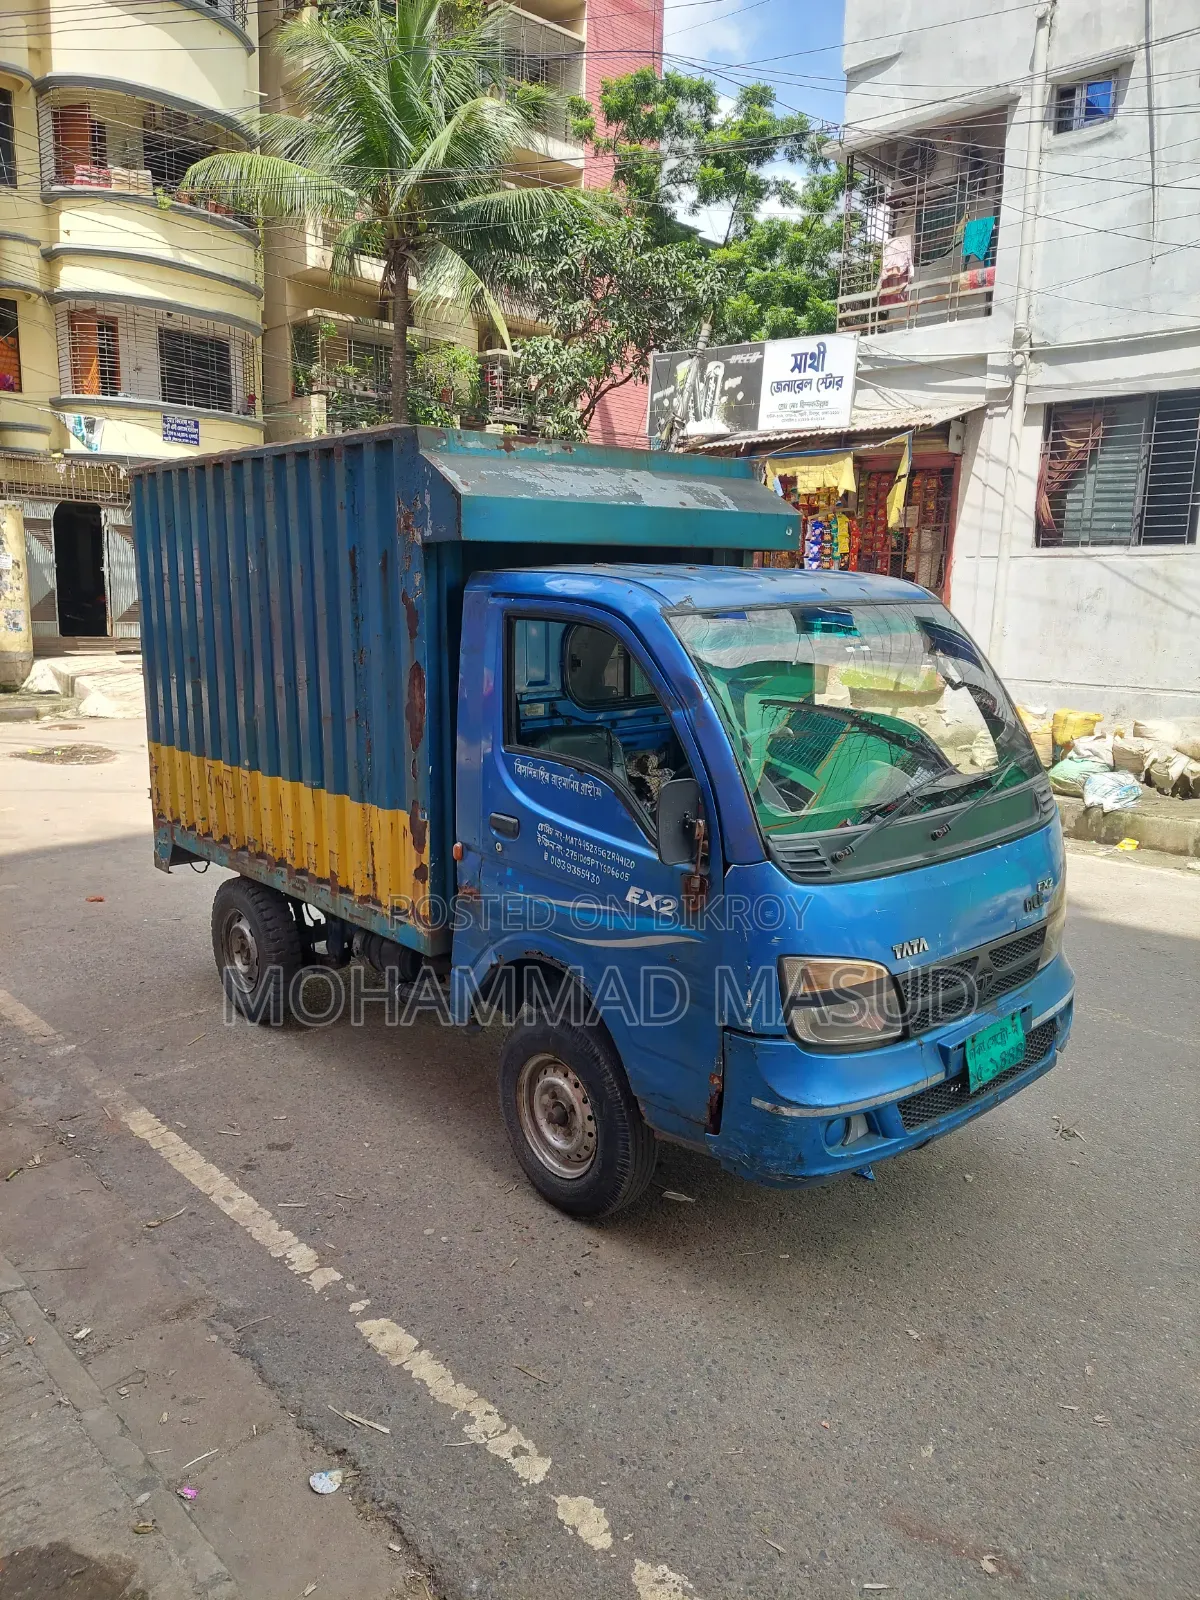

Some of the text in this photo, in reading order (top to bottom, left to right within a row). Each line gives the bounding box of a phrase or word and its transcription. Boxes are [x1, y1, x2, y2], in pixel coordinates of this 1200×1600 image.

[790, 341, 827, 373] সাথী
[770, 373, 844, 396] জেনারেল স্টোর
[625, 886, 677, 916] EX2
[892, 937, 929, 960] TATA
